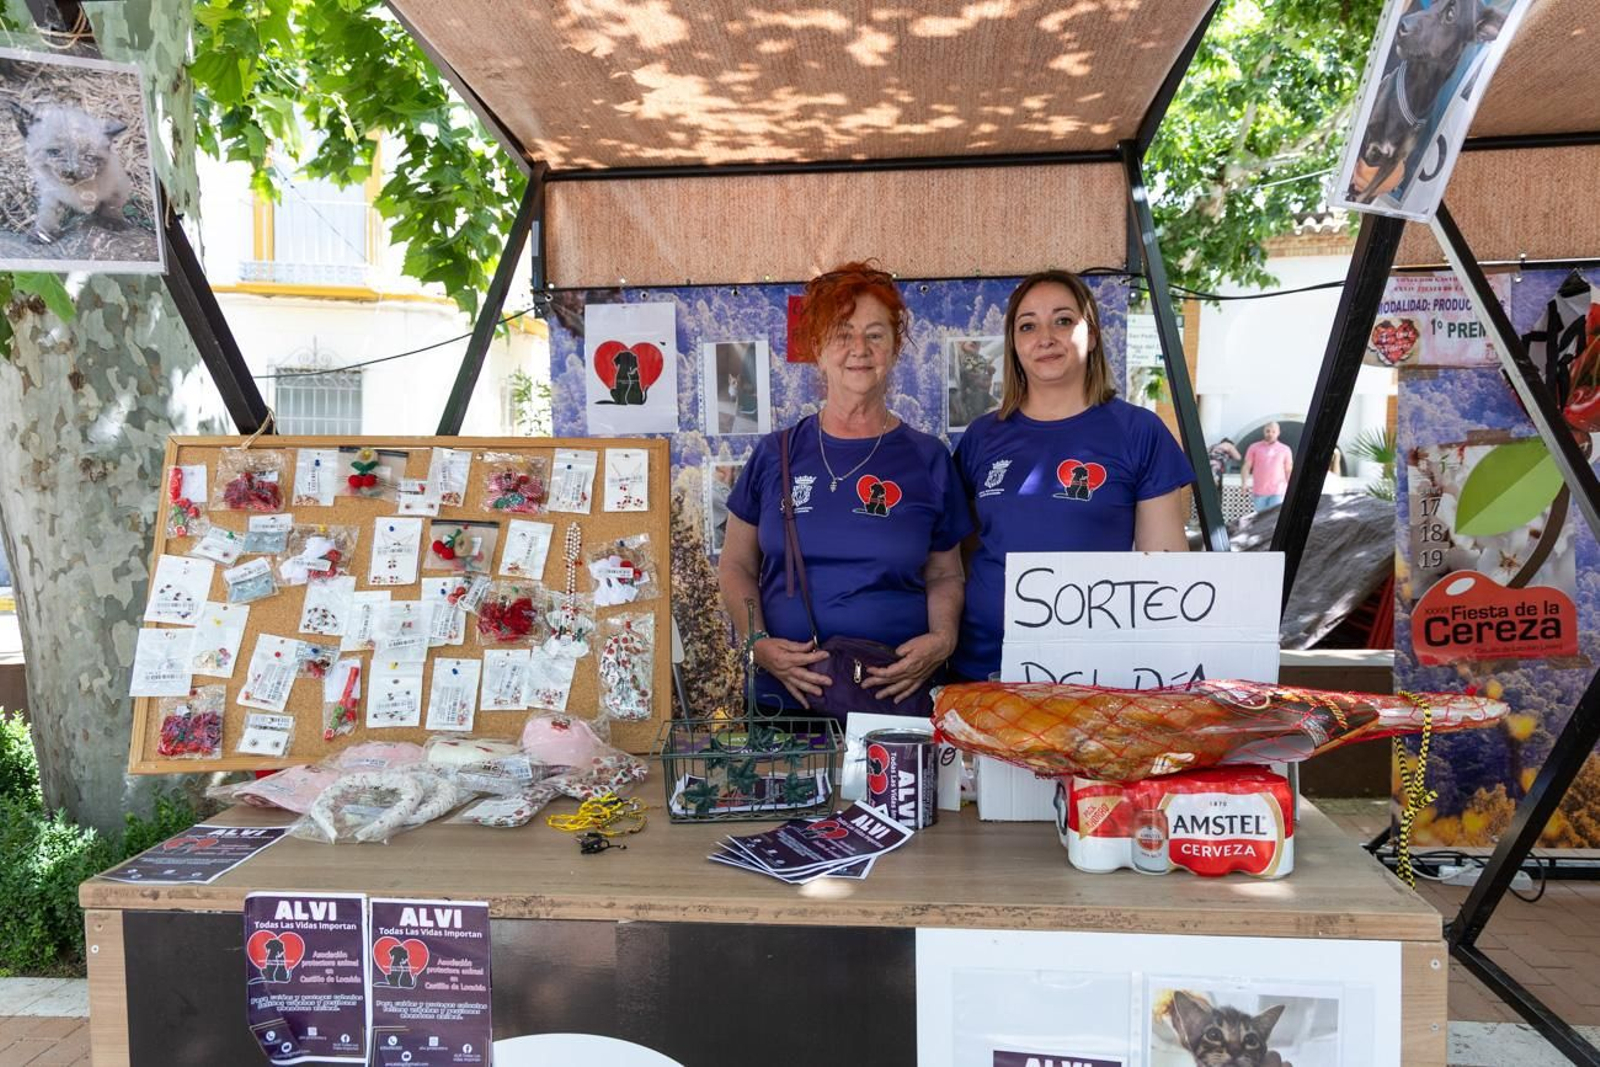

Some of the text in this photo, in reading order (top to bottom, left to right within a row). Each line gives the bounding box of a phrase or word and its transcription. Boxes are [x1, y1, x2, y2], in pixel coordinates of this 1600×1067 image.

[1433, 299, 1472, 311] PRODUC
[1420, 498, 1441, 516] 17
[1420, 523, 1443, 543] 18
[1420, 549, 1443, 568] 19
[1014, 567, 1216, 629] SORTEO
[1451, 605, 1509, 621] Fiesta
[1514, 601, 1538, 616] de
[1543, 600, 1559, 615] la
[1424, 616, 1562, 647] Cereza
[898, 770, 915, 828] ALVI
[207, 828, 267, 836] ALVI
[850, 814, 891, 840] ALVI
[1172, 814, 1267, 836] AMSTEL
[1181, 843, 1257, 858] CERVEZA
[274, 900, 337, 921] ALVI
[399, 907, 462, 929] ALVI
[254, 921, 279, 929] Todas
[295, 922, 317, 930] Vidas
[319, 923, 357, 931] Importan
[379, 927, 404, 935] Todas
[444, 930, 482, 939] Importan
